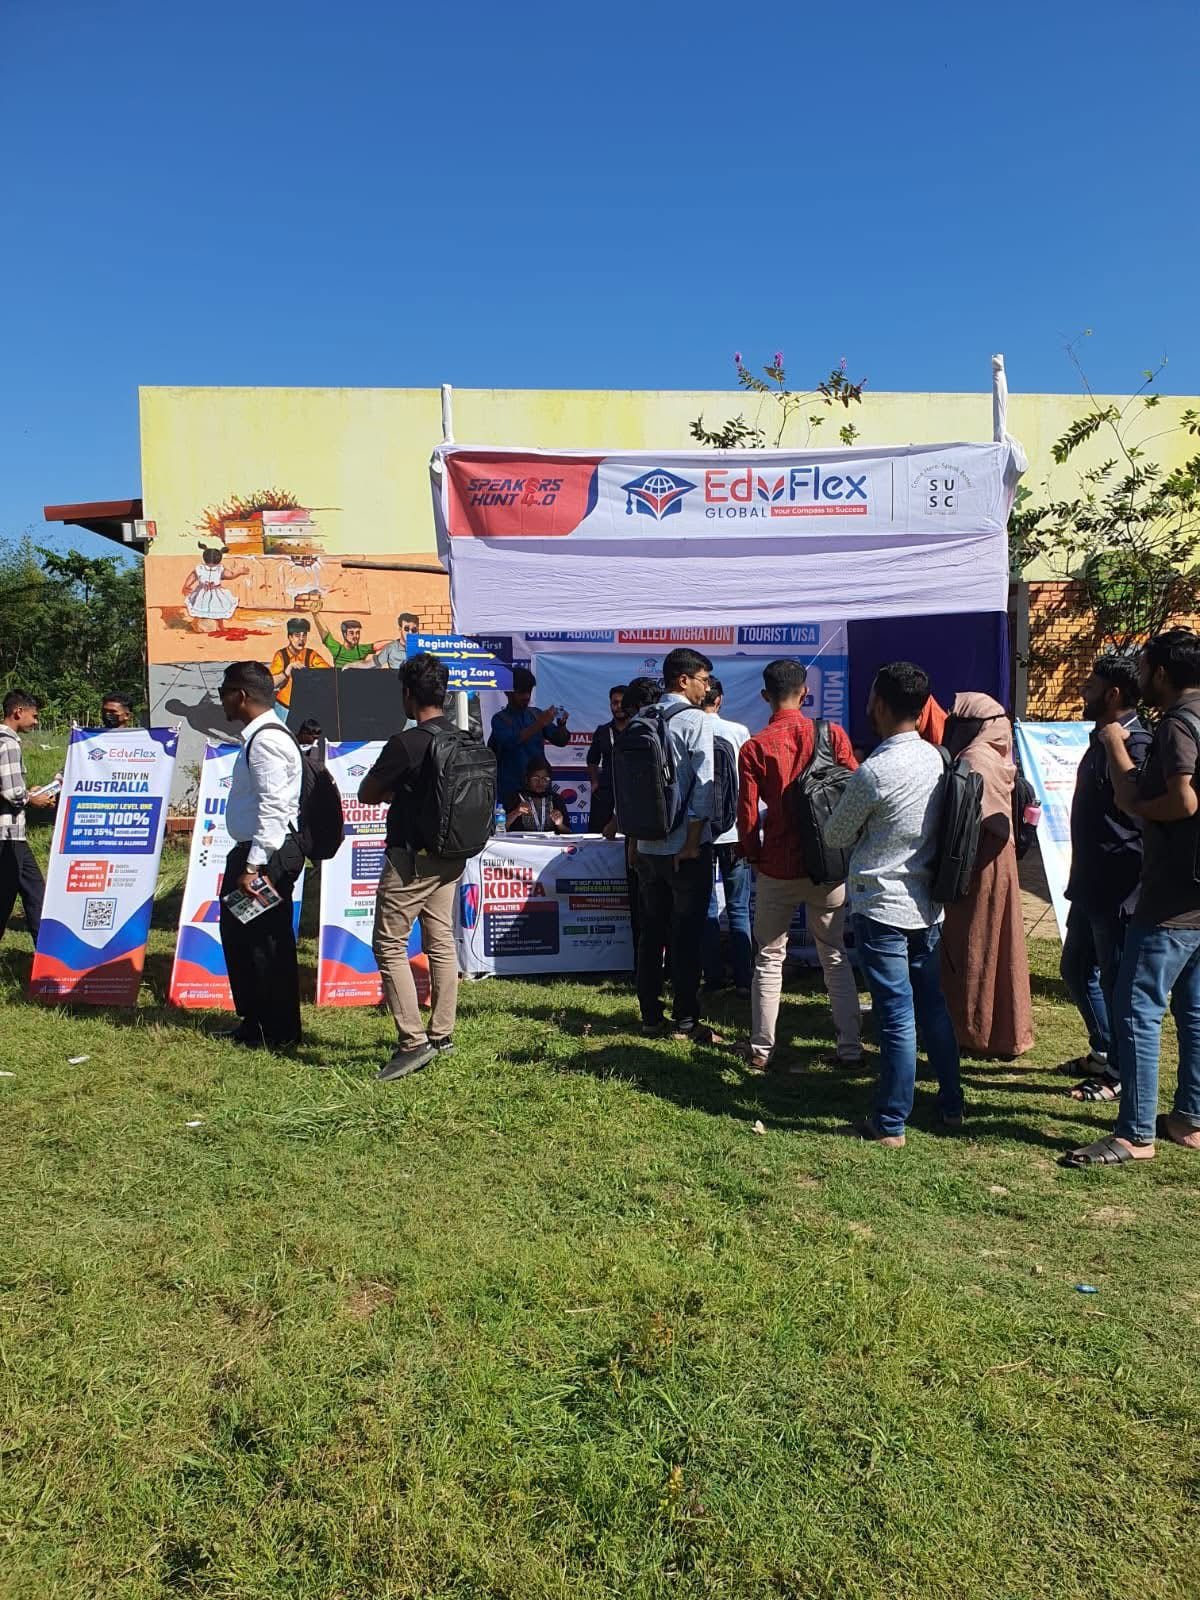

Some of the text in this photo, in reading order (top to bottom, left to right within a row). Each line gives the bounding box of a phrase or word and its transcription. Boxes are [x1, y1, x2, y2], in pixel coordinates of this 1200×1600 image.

[705, 466, 868, 502] EduFlex
[470, 493, 556, 507] HUNT 4.0
[705, 507, 767, 519] GLOBAL
[791, 506, 825, 514] Compass
[826, 506, 834, 514] to
[835, 506, 865, 514] Success
[621, 627, 731, 641] SKILLED MIGRATION
[742, 626, 816, 642] TOURIST VISA
[418, 639, 502, 650] Registration First
[470, 667, 495, 677] Zone
[109, 748, 156, 758] EduFlex
[112, 772, 149, 780] STUDY IN
[74, 780, 149, 792] AUSTRALIA
[108, 812, 150, 826] 100%
[483, 858, 505, 866] STUDY
[484, 867, 532, 881] SOUTH
[484, 881, 546, 898] KOREA
